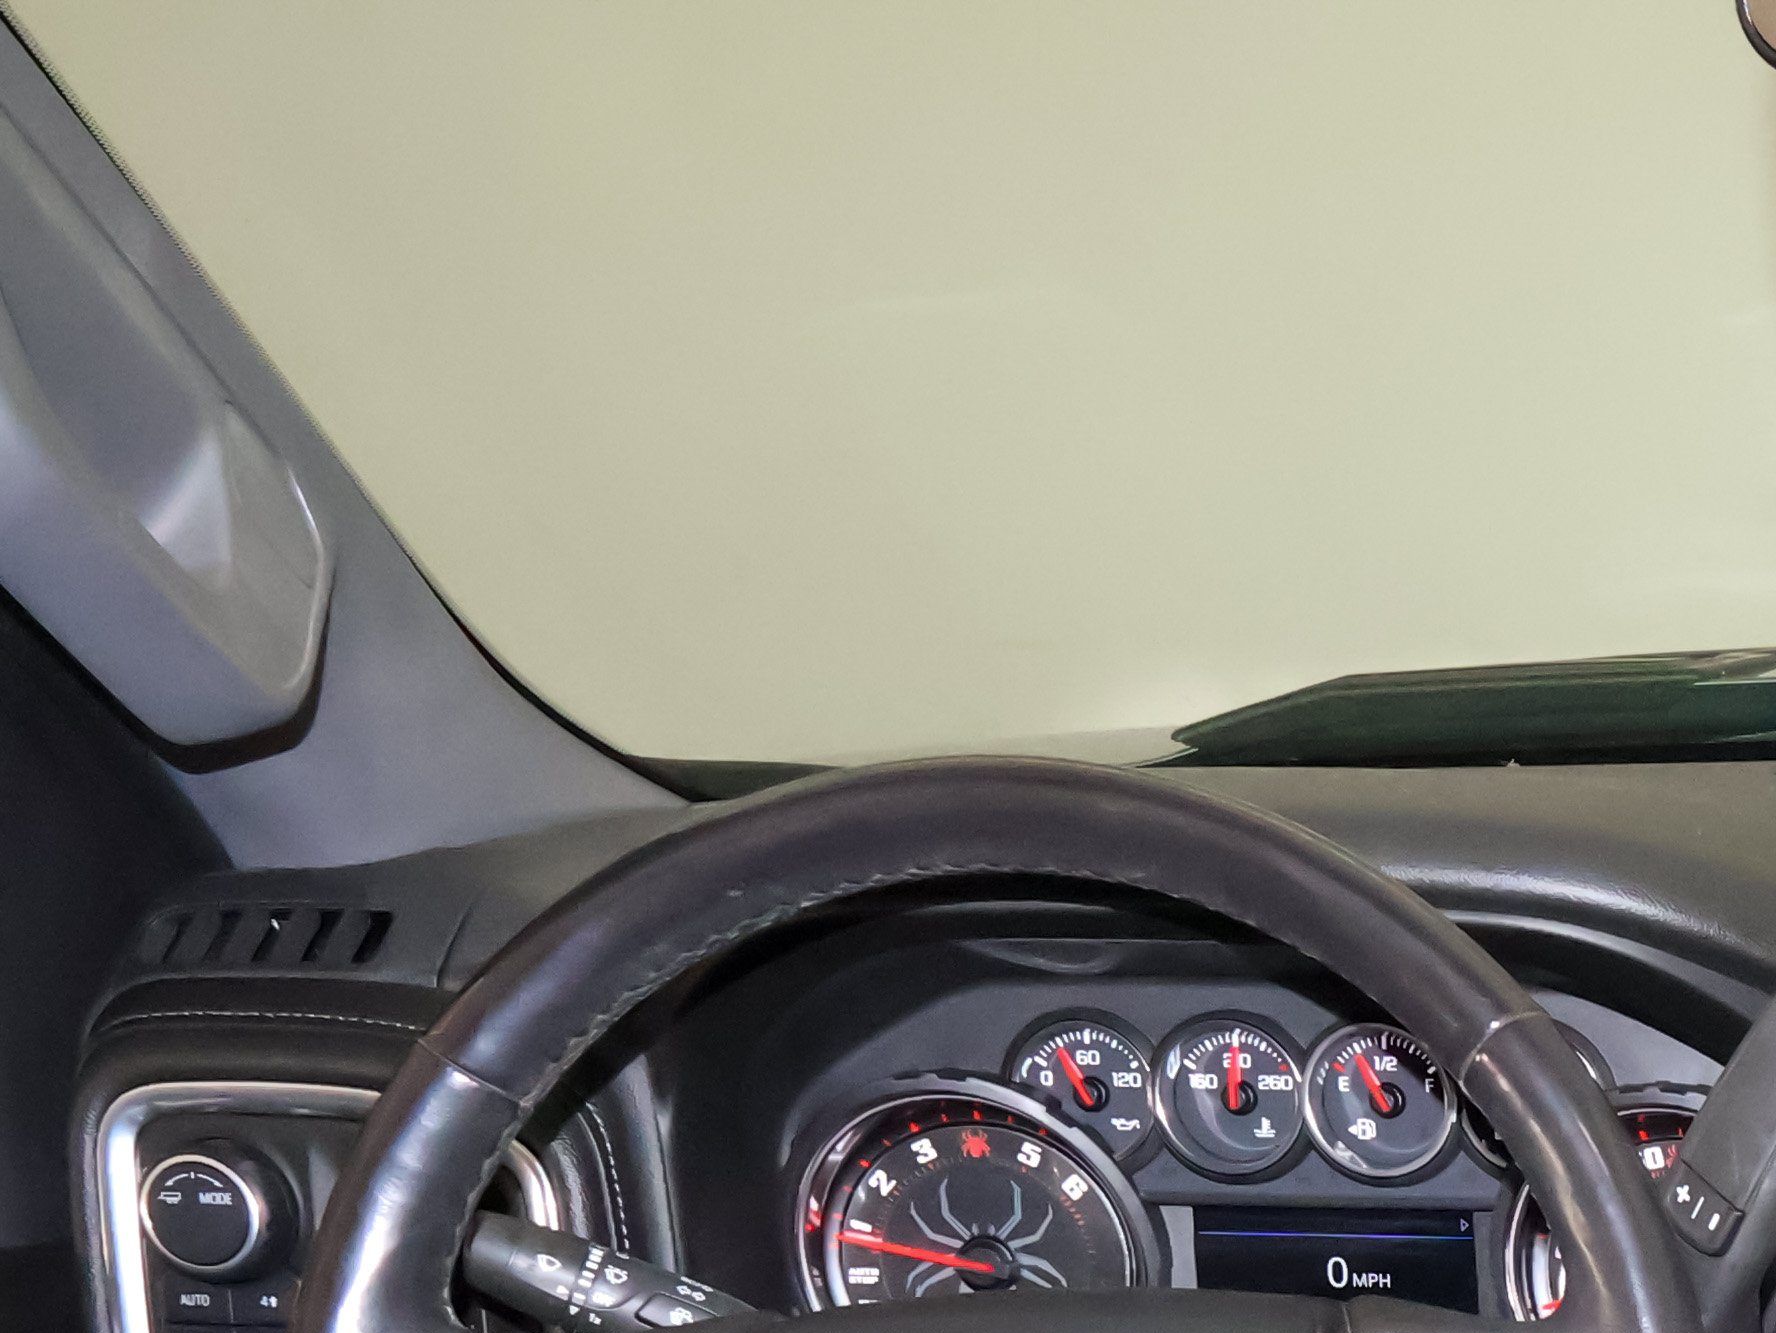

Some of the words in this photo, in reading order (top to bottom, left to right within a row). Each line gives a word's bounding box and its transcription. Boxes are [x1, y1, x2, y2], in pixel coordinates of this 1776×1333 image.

[1075, 1050, 1101, 1066] 60
[1222, 1053, 1251, 1069] 20
[1373, 1055, 1398, 1072] 1/2
[1040, 1071, 1054, 1086] 0
[1111, 1072, 1142, 1088] 120
[1188, 1073, 1218, 1089] 160
[1257, 1075, 1293, 1091] 260
[1338, 1076, 1350, 1092] E
[1424, 1078, 1435, 1093] F
[911, 1138, 938, 1164] 3
[1017, 1141, 1042, 1168] 5
[1638, 1145, 1665, 1171] 0
[868, 1169, 897, 1197] 2
[1061, 1174, 1089, 1201] 6
[198, 1192, 233, 1205] MODE
[1327, 1256, 1349, 1289] 0
[1352, 1272, 1391, 1289] MPH
[180, 1294, 211, 1307] AUTO
